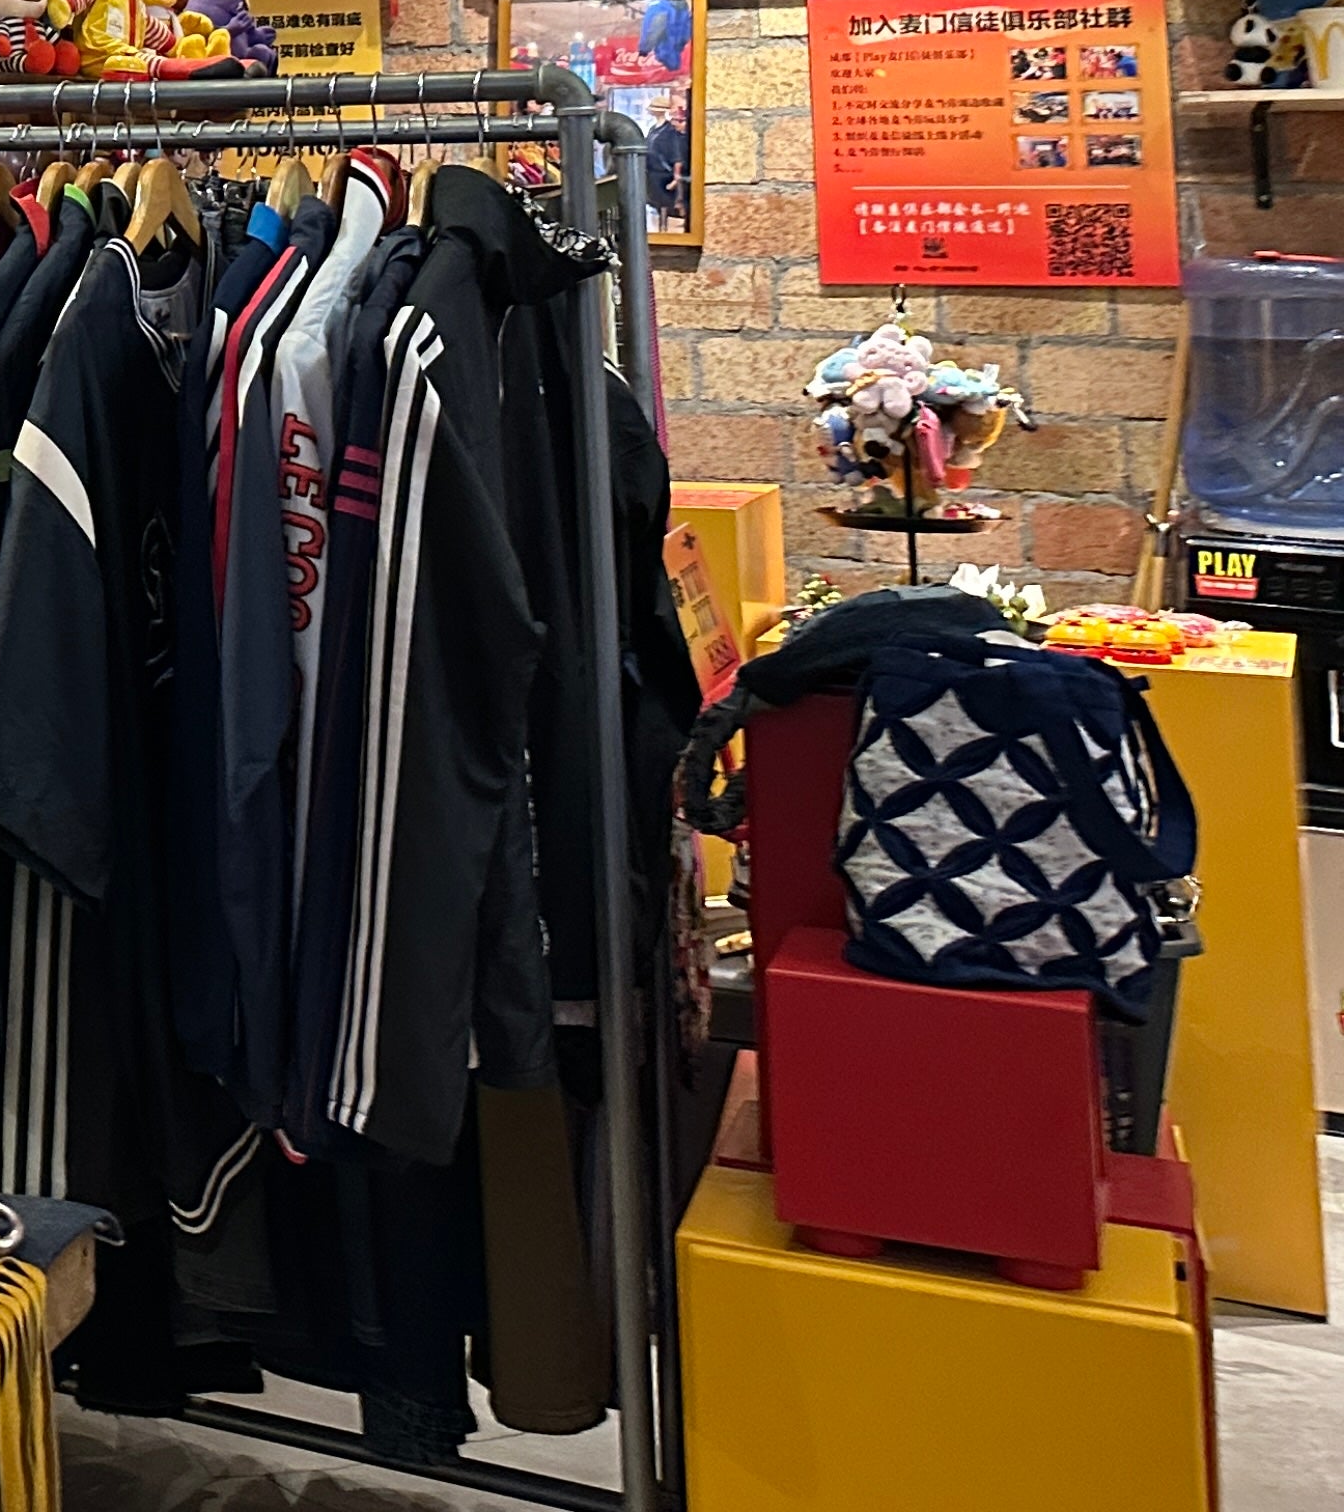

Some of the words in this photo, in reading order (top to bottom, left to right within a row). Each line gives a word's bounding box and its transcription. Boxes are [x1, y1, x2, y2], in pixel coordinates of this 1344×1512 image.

[849, 6, 1134, 36] 加入麦门信徒俱乐部社群
[274, 41, 356, 58] 买前检查好
[1197, 550, 1257, 578] PLAY
